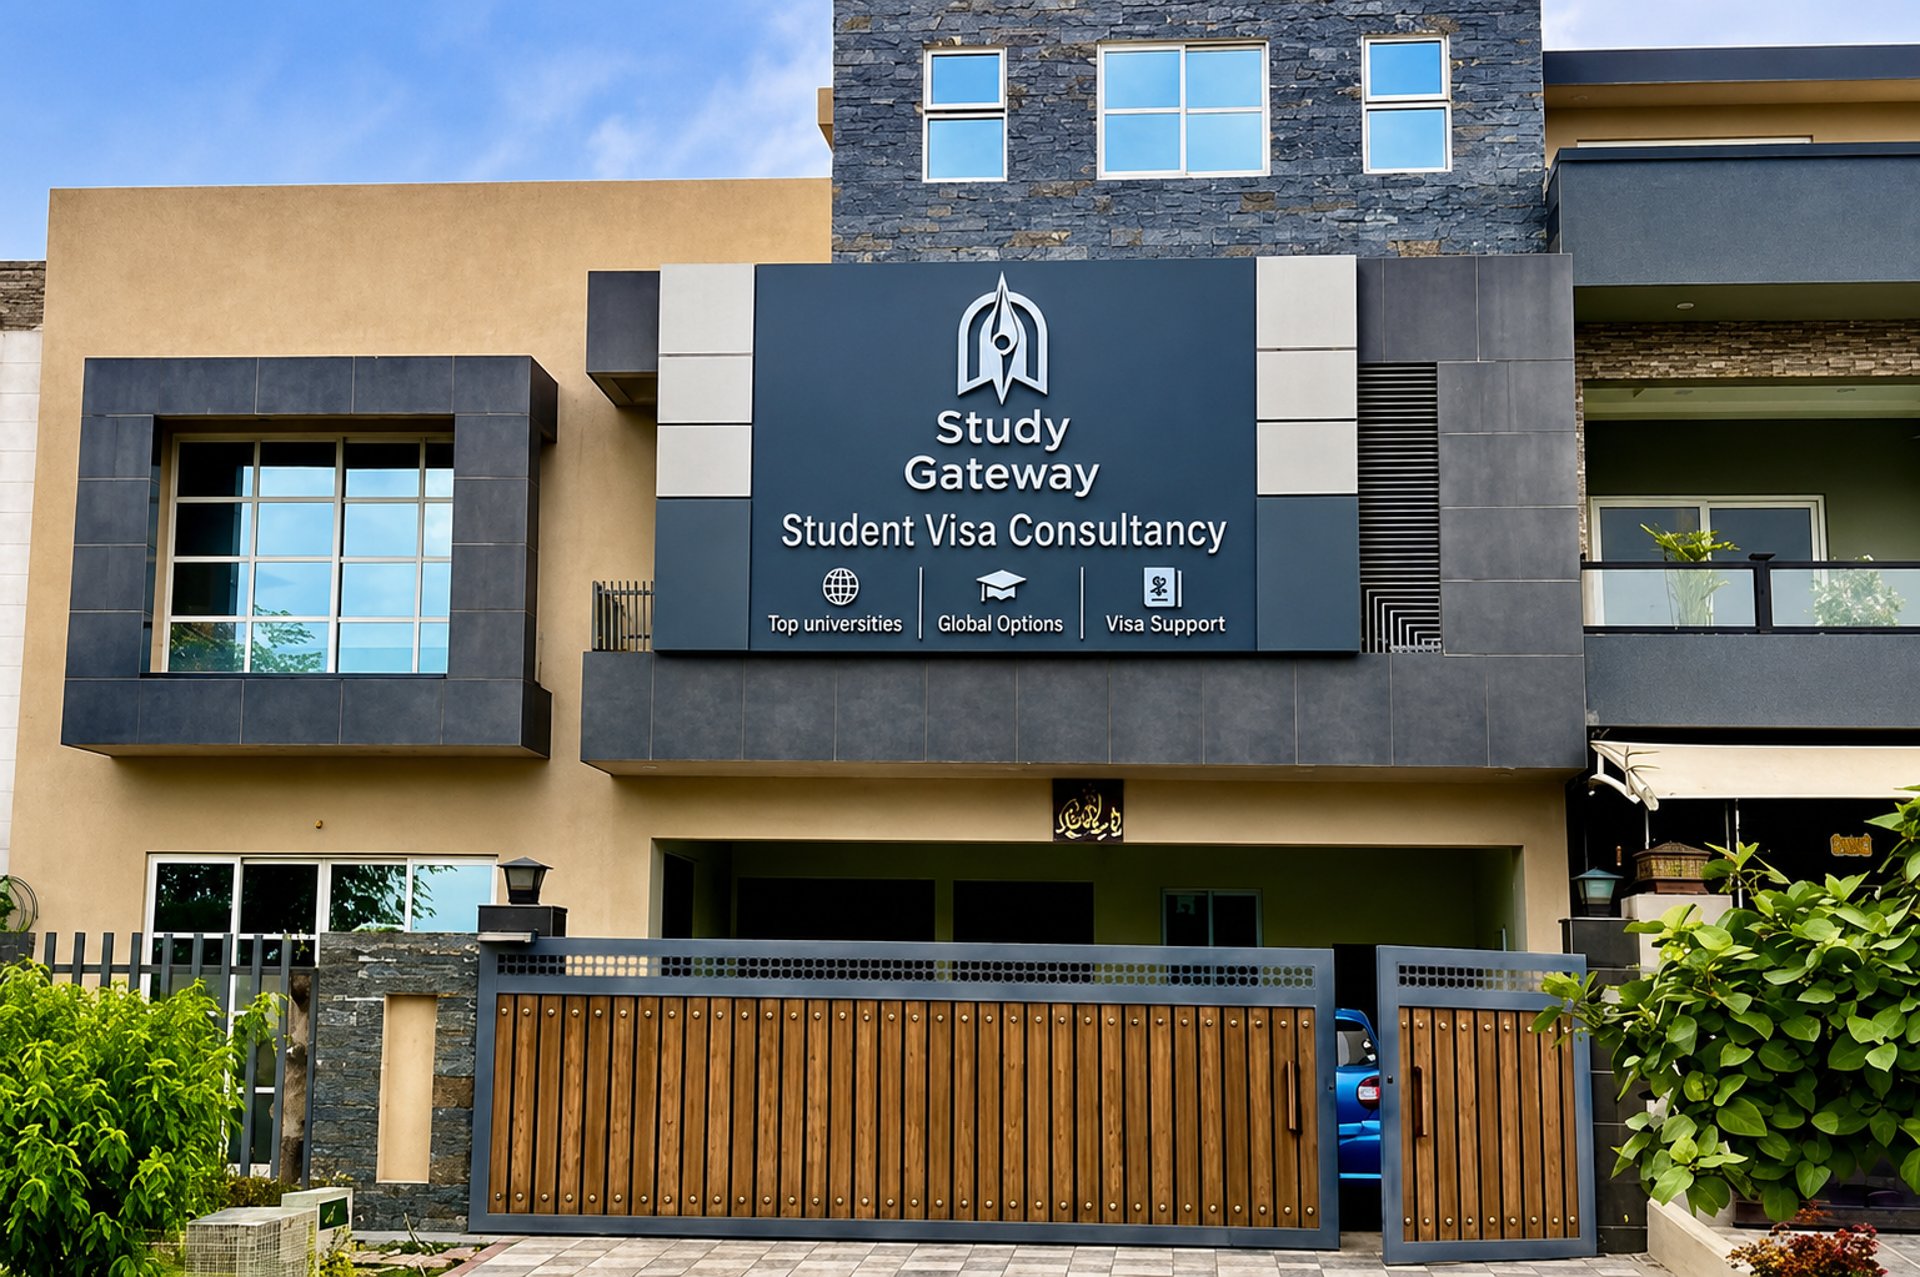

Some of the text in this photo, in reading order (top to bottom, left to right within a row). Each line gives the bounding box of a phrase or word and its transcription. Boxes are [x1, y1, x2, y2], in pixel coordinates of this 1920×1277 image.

[936, 408, 1070, 452] Study
[904, 455, 1100, 498] Gateway
[781, 512, 1227, 554] Student Visa Consultancy
[767, 614, 903, 636] Top universities
[938, 613, 1064, 637] Global Options
[1105, 613, 1226, 636] Visa Support
